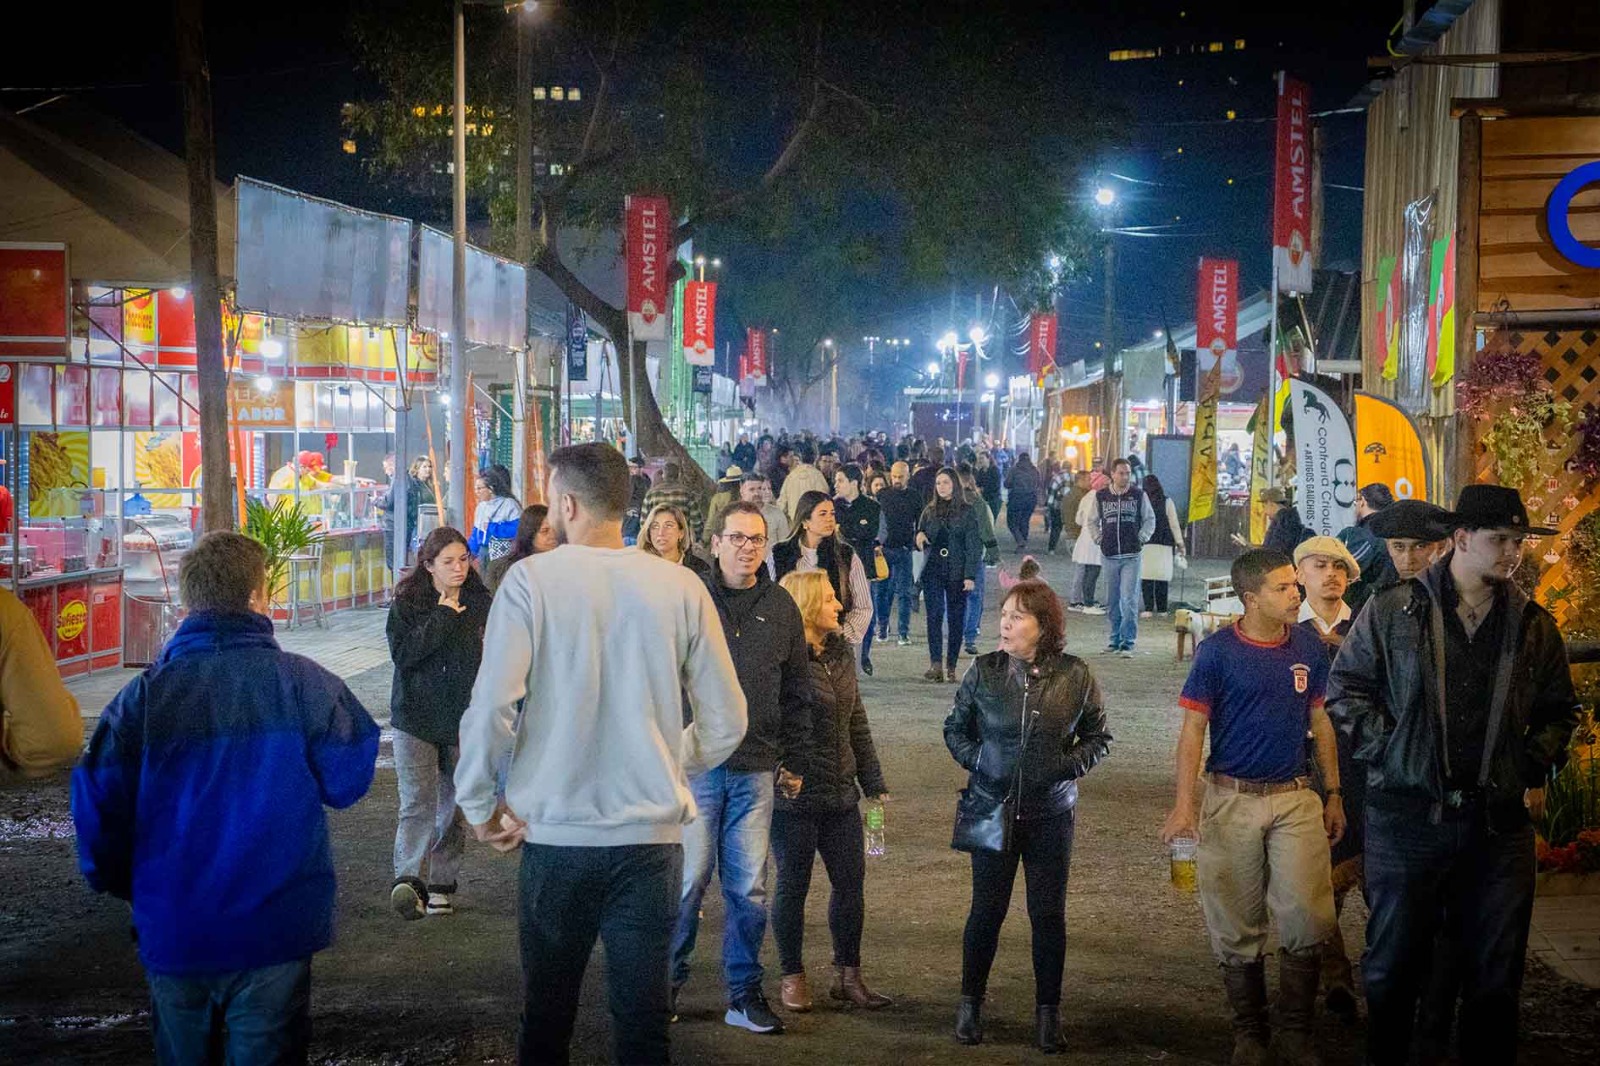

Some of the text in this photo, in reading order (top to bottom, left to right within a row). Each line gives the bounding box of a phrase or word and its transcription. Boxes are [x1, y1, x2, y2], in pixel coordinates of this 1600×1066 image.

[1288, 90, 1304, 219] AMSTEL
[643, 203, 657, 291] AMSTEL
[695, 285, 708, 336] AMSTEL
[1211, 264, 1227, 333] AMSTEL
[752, 332, 761, 366] AMSTEL
[1304, 449, 1314, 483] ARTIGOS
[1316, 427, 1331, 487] Confraria
